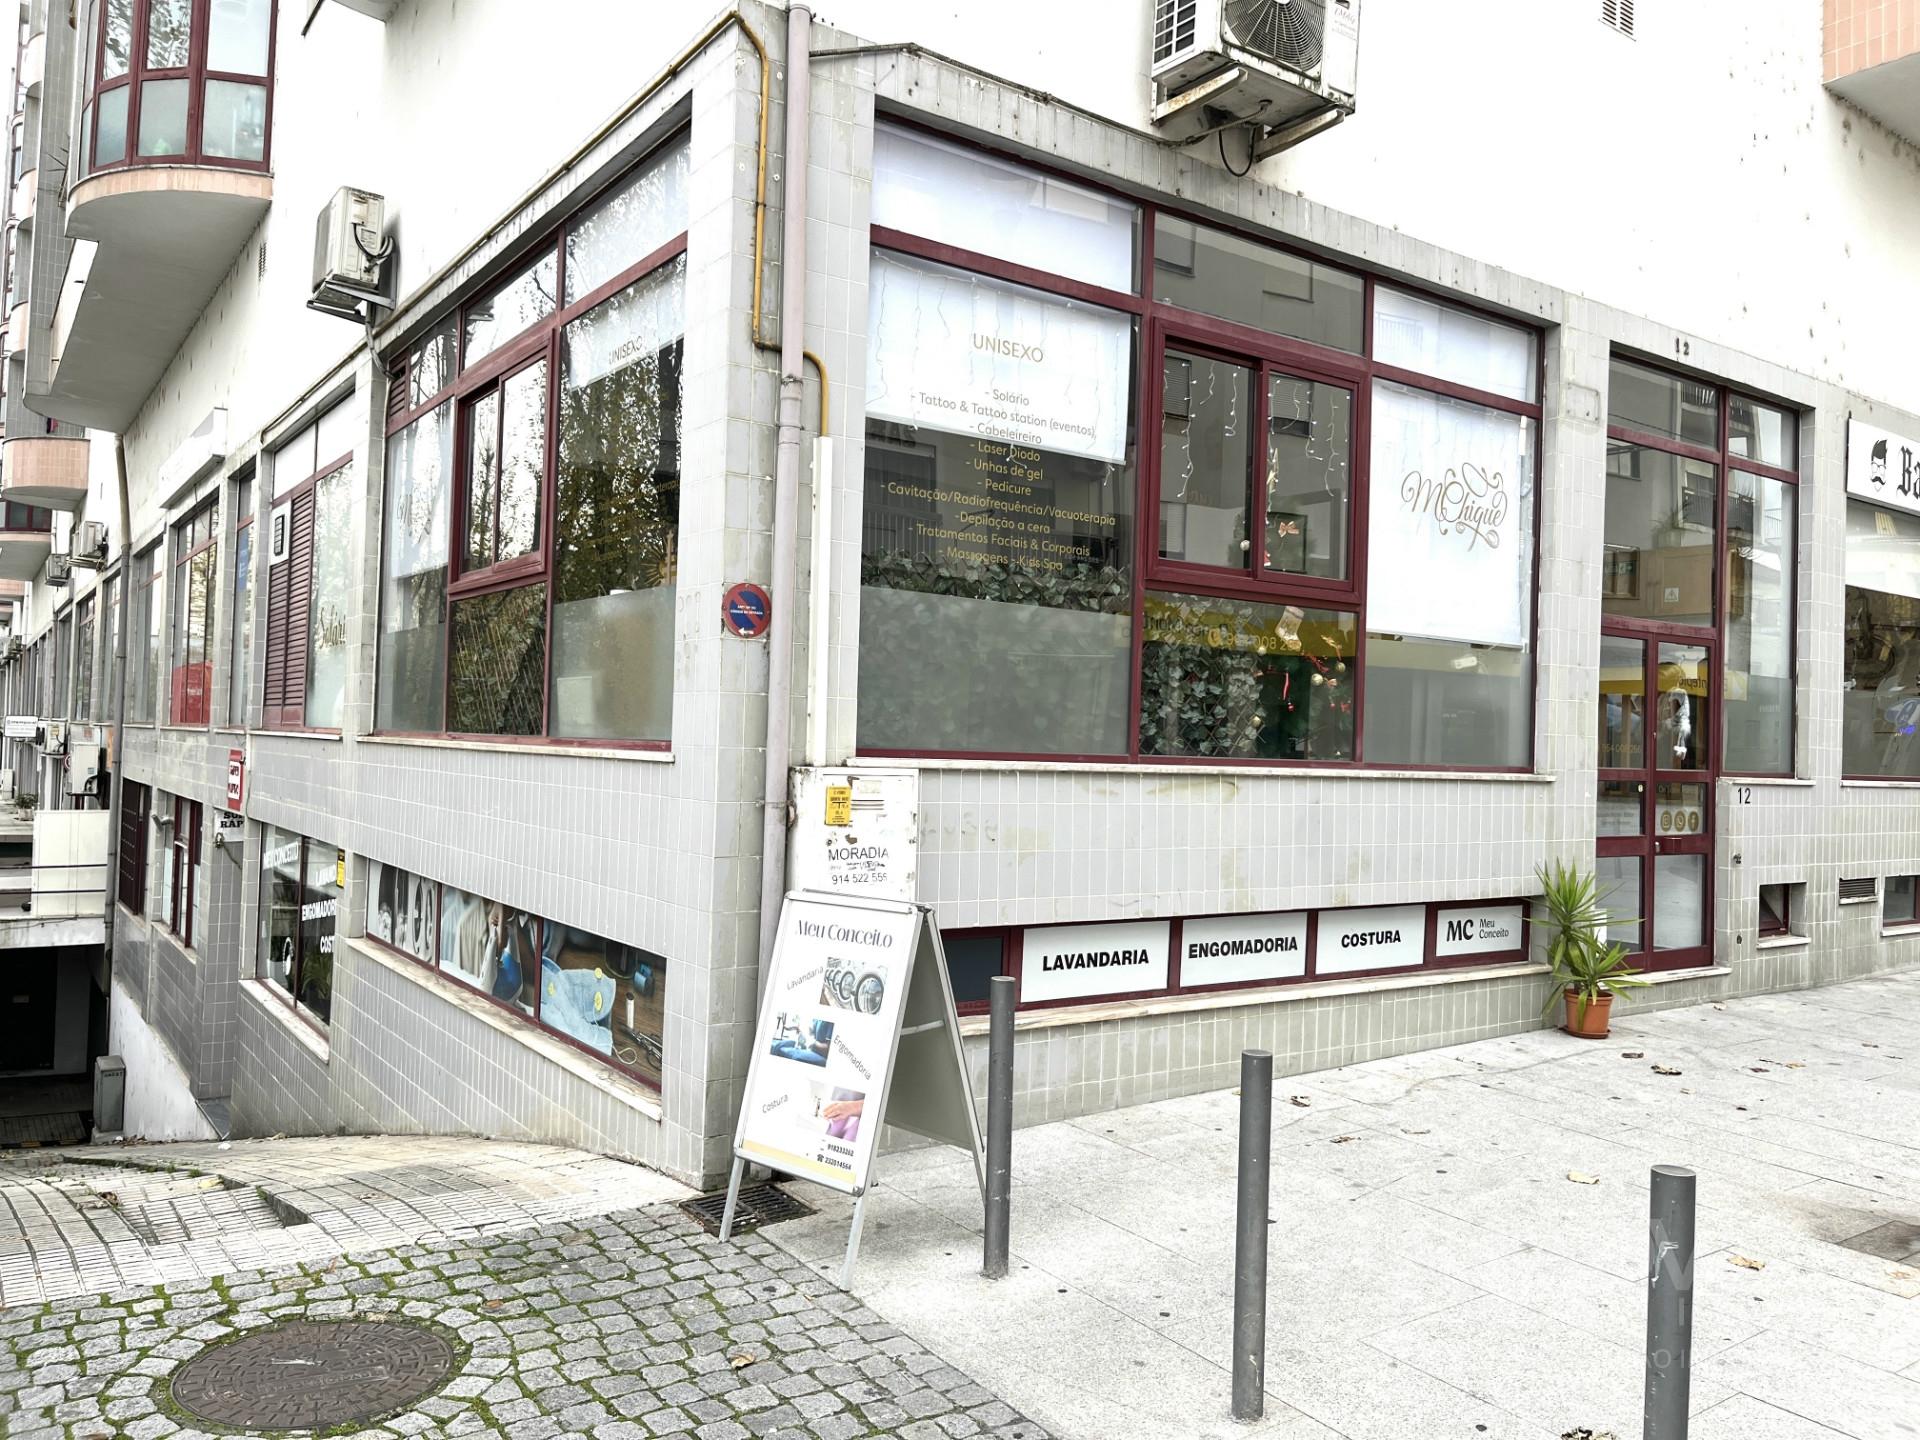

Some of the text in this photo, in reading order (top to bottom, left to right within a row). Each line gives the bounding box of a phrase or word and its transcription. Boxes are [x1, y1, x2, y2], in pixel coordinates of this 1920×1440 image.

[973, 333, 1044, 363] UNISEXO
[1675, 337, 1690, 356] 12
[992, 389, 1030, 406] Solário
[919, 392, 956, 410] Tattoo
[971, 402, 1008, 420] Tattoo
[1009, 412, 1047, 427] station
[977, 422, 1042, 444] Cabeleireiro
[978, 441, 1041, 462] Laser Diodo
[973, 458, 1043, 482] Unhas de gel
[985, 478, 1032, 496] Pedicure
[887, 482, 1116, 527] Cavitação/Radiofrequência/Vacuoterapia
[1017, 522, 1025, 531] a
[1026, 523, 1051, 534] cera
[916, 523, 989, 545] Tratamentos
[991, 533, 1028, 549] Faciais
[1041, 539, 1091, 557] Corporais
[946, 547, 1009, 566] Massagens
[1738, 788, 1751, 804] 12
[828, 846, 889, 861] MORADIA
[832, 874, 850, 885] 914
[852, 873, 869, 883] 522
[827, 923, 893, 948] Conceito
[1341, 929, 1401, 948] COSTURA
[1446, 918, 1495, 942] MC Meu
[1479, 927, 1509, 940] Conceito
[1188, 936, 1298, 959] ENGOMADORIA
[1042, 949, 1149, 972] LAVANDARIA
[787, 966, 824, 991] Lavandaria
[833, 1034, 872, 1081] Engomadoria
[762, 1094, 789, 1114] Costura
